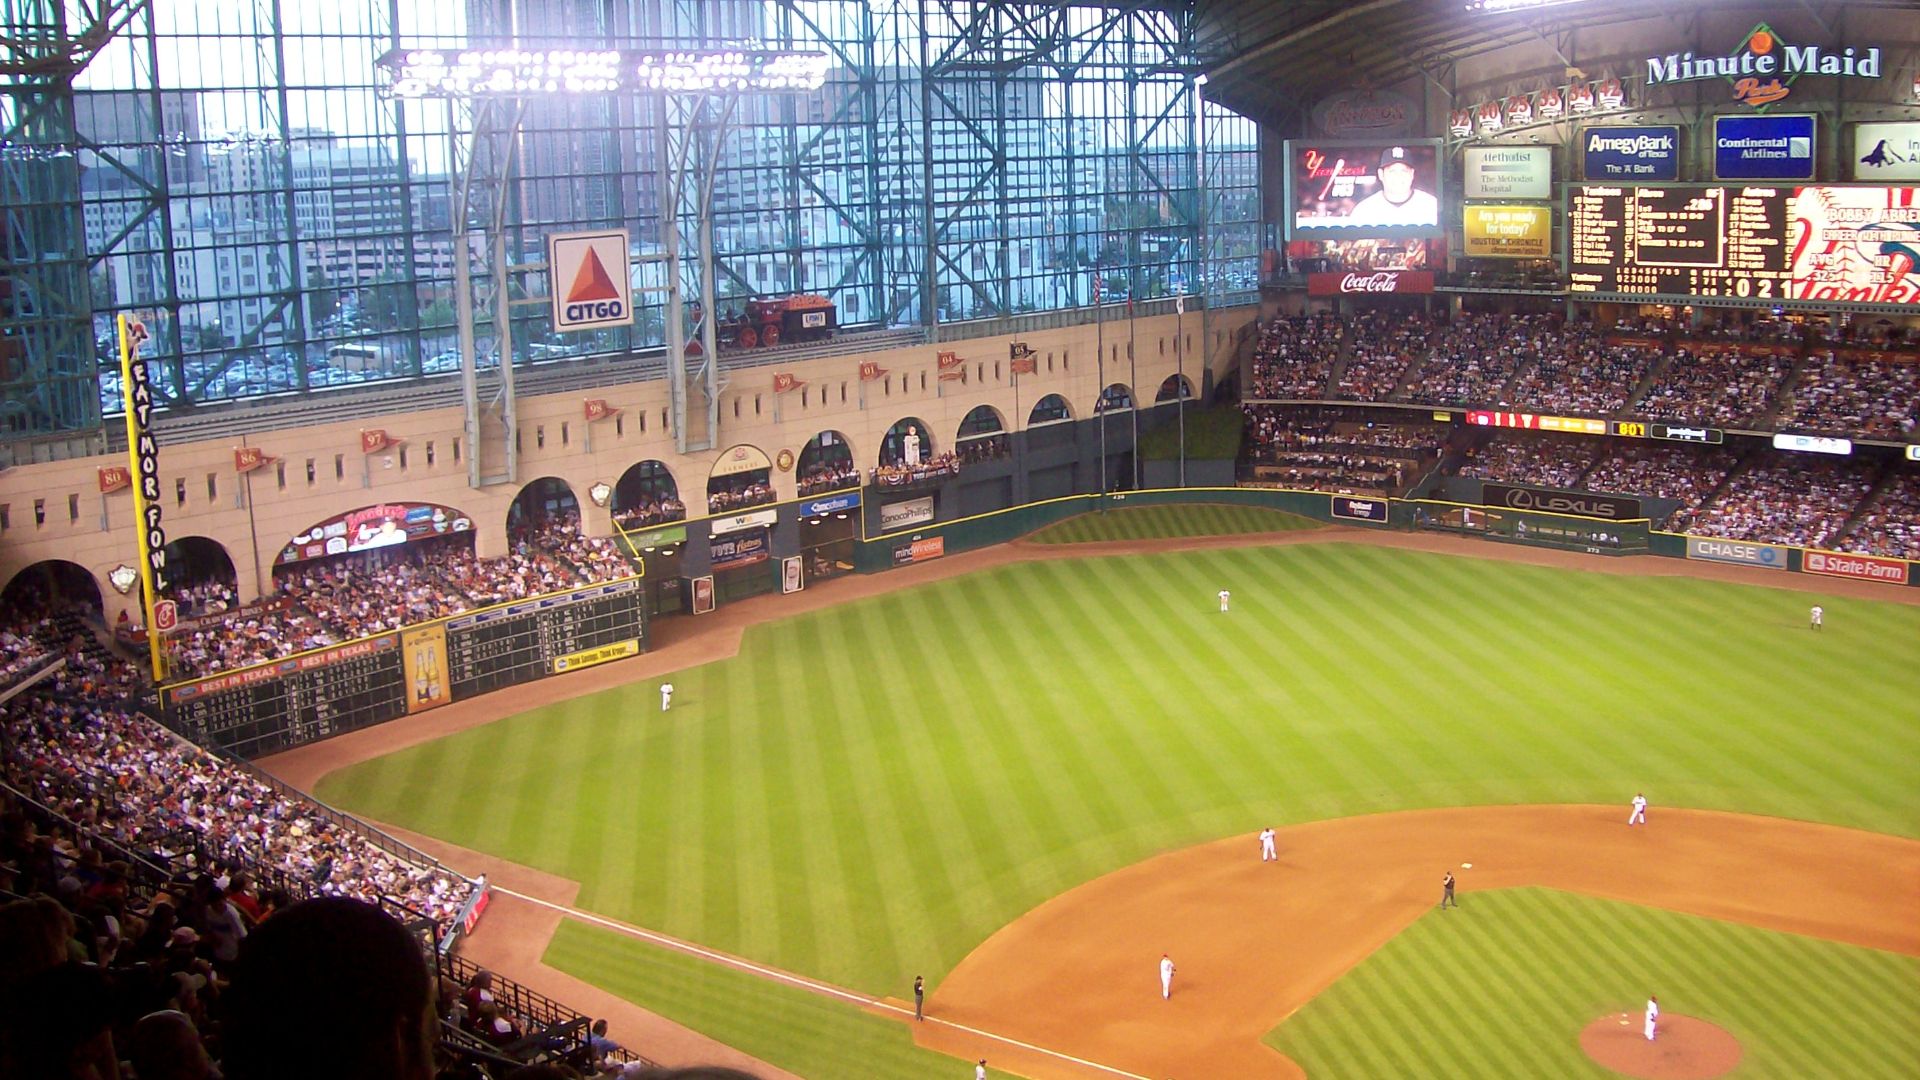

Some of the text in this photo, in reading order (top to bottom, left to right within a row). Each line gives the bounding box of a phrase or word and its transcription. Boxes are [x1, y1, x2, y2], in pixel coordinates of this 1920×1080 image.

[1645, 45, 1881, 84] Minute Maid
[1600, 78, 1621, 96] 42
[1733, 78, 1790, 104] Park
[1479, 103, 1498, 119] 40
[1509, 96, 1528, 112] 25
[1588, 134, 1673, 154] AmegyBank
[1717, 137, 1788, 148] Continental
[1647, 150, 1668, 158] Texas
[1741, 148, 1788, 159] Airlines
[1606, 164, 1655, 173] The Bank
[1481, 175, 1534, 183] The Methodist
[1481, 184, 1512, 194] Hospital
[1479, 209, 1536, 224] Are you ready
[1828, 208, 1873, 222] BOBBY
[1486, 222, 1530, 237] for today?
[1809, 253, 1835, 266] AVG
[1736, 278, 1792, 299] 0 2 1
[566, 301, 622, 321] CITGO
[132, 363, 149, 425] EAT
[1619, 422, 1645, 435] 8:07
[141, 434, 157, 497] MOR
[104, 472, 121, 484] 80
[881, 506, 932, 524] ConocoPhillips
[1534, 497, 1616, 517] LEXUS
[147, 508, 168, 592] FOWL
[1698, 541, 1756, 560] CHASE
[1826, 556, 1901, 579] State Farm
[302, 656, 326, 669] BEST
[327, 651, 340, 662] IN
[340, 642, 372, 658] TEXAS
[201, 679, 227, 693] BEST
[229, 675, 242, 686] IN
[243, 667, 276, 683] TEXAS
